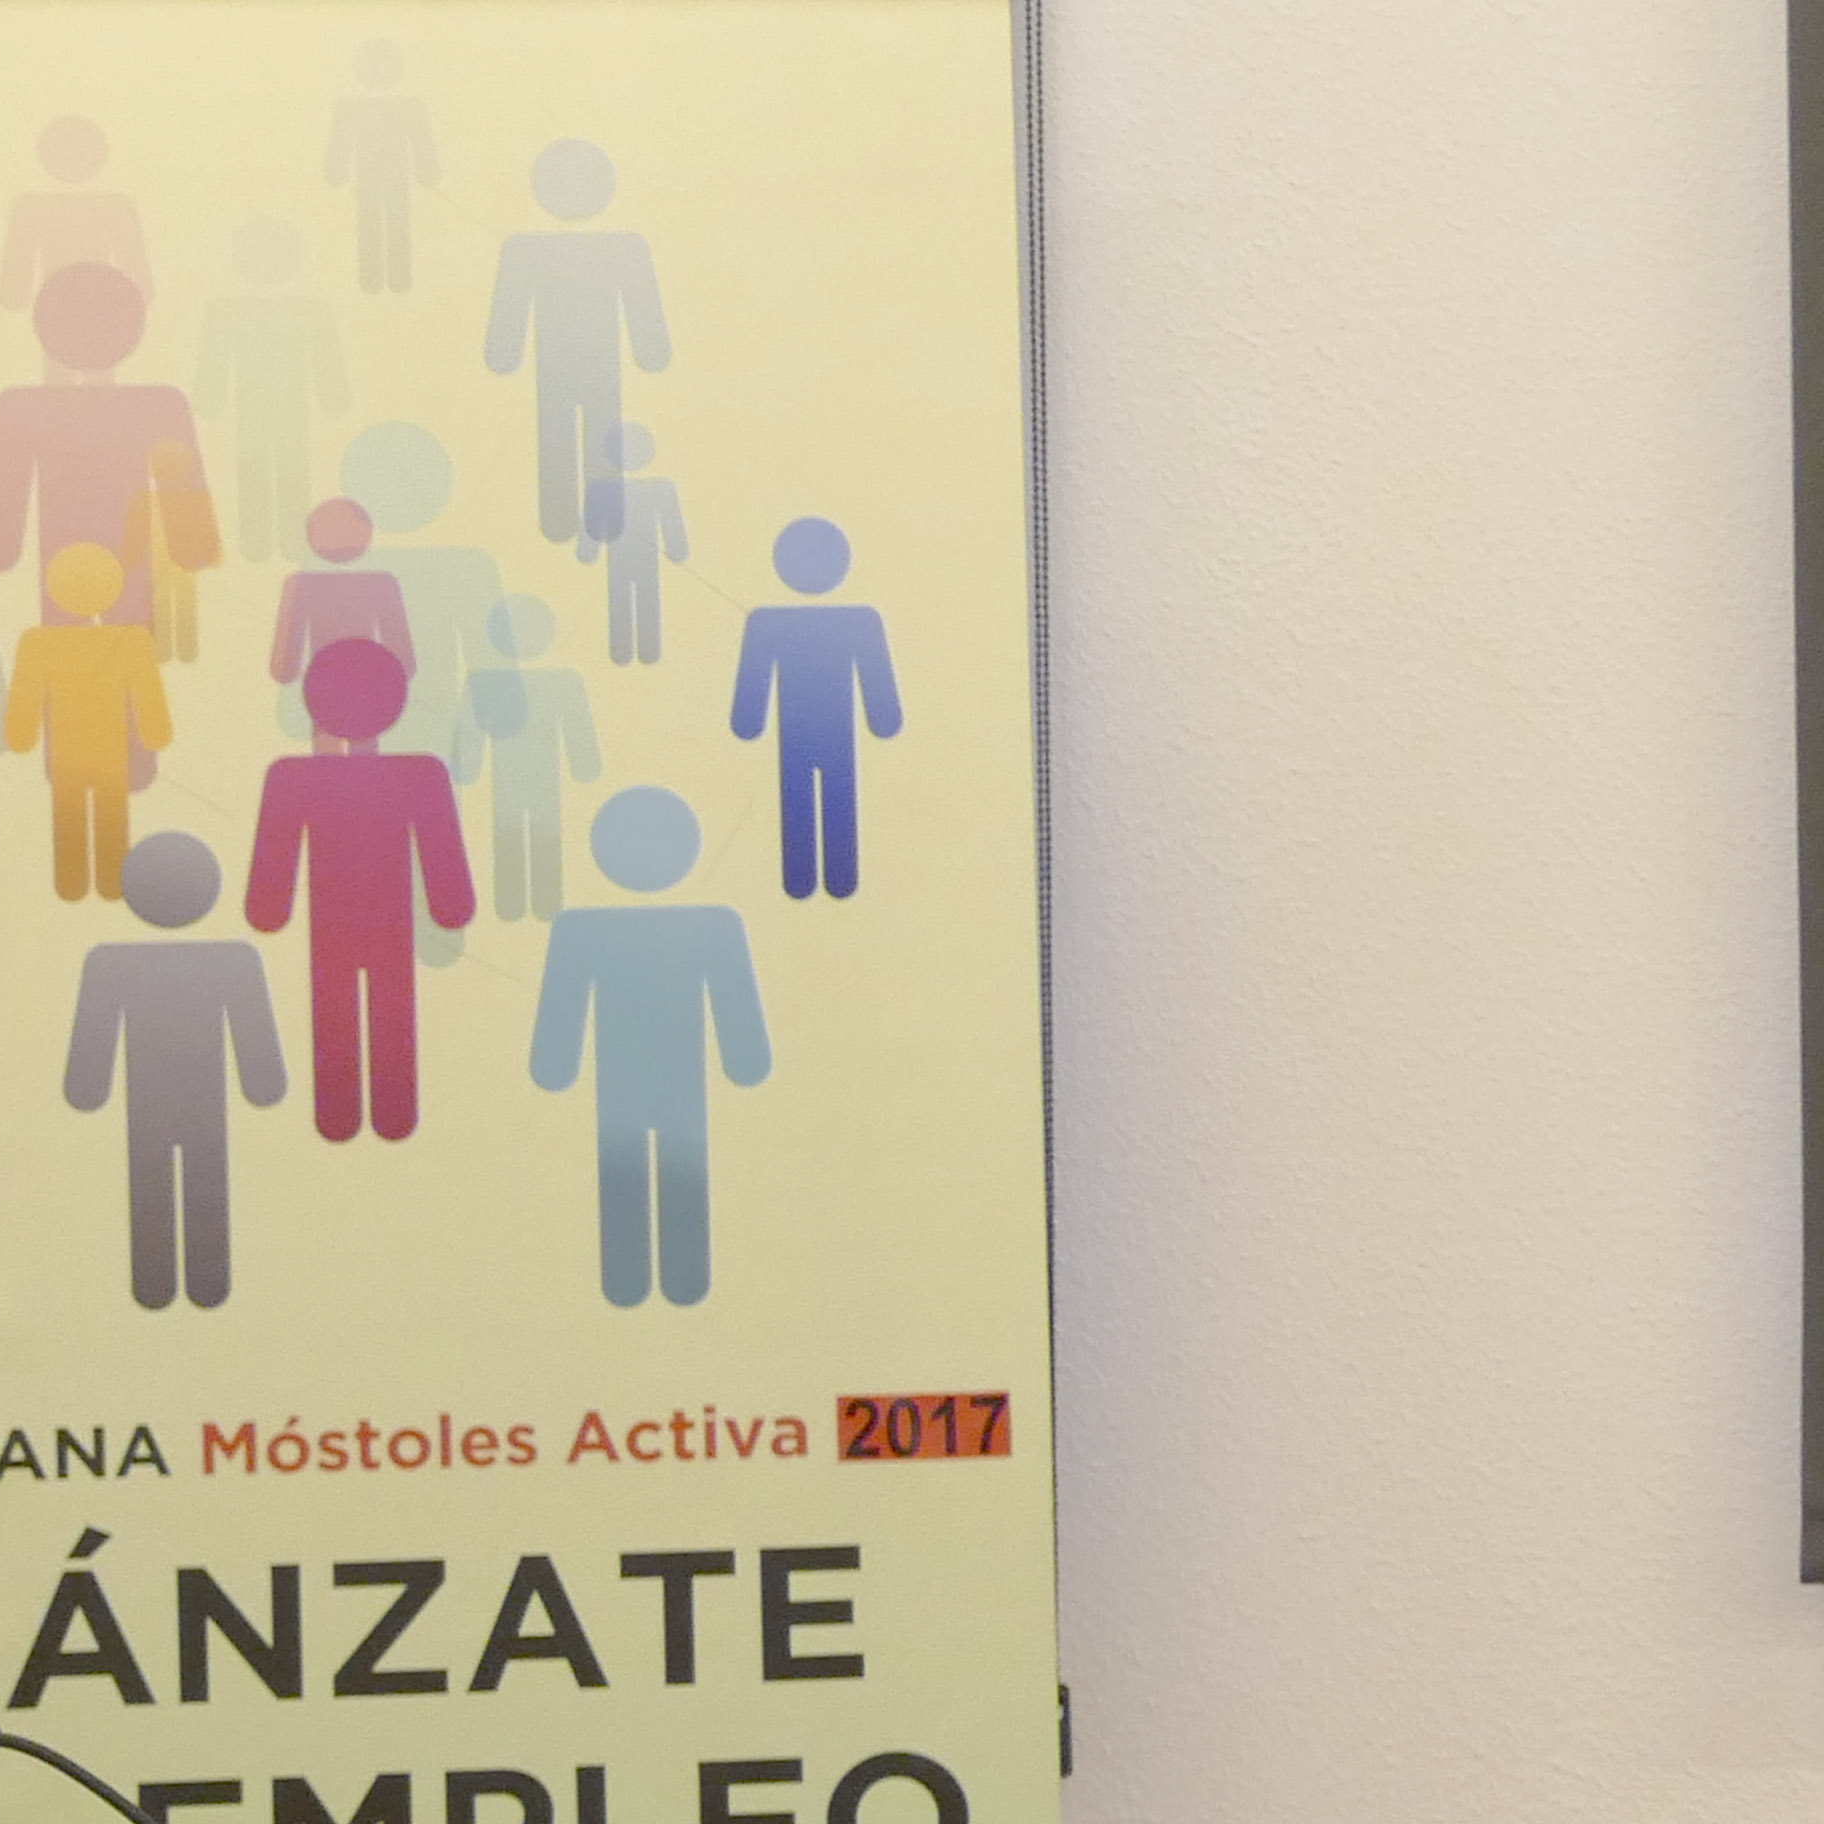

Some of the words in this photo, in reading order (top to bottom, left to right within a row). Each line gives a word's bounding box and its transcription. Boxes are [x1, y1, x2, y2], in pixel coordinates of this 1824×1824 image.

[202, 1415, 539, 1475] Móstoles
[567, 1403, 809, 1464] Activa
[844, 1393, 1010, 1460] 2017
